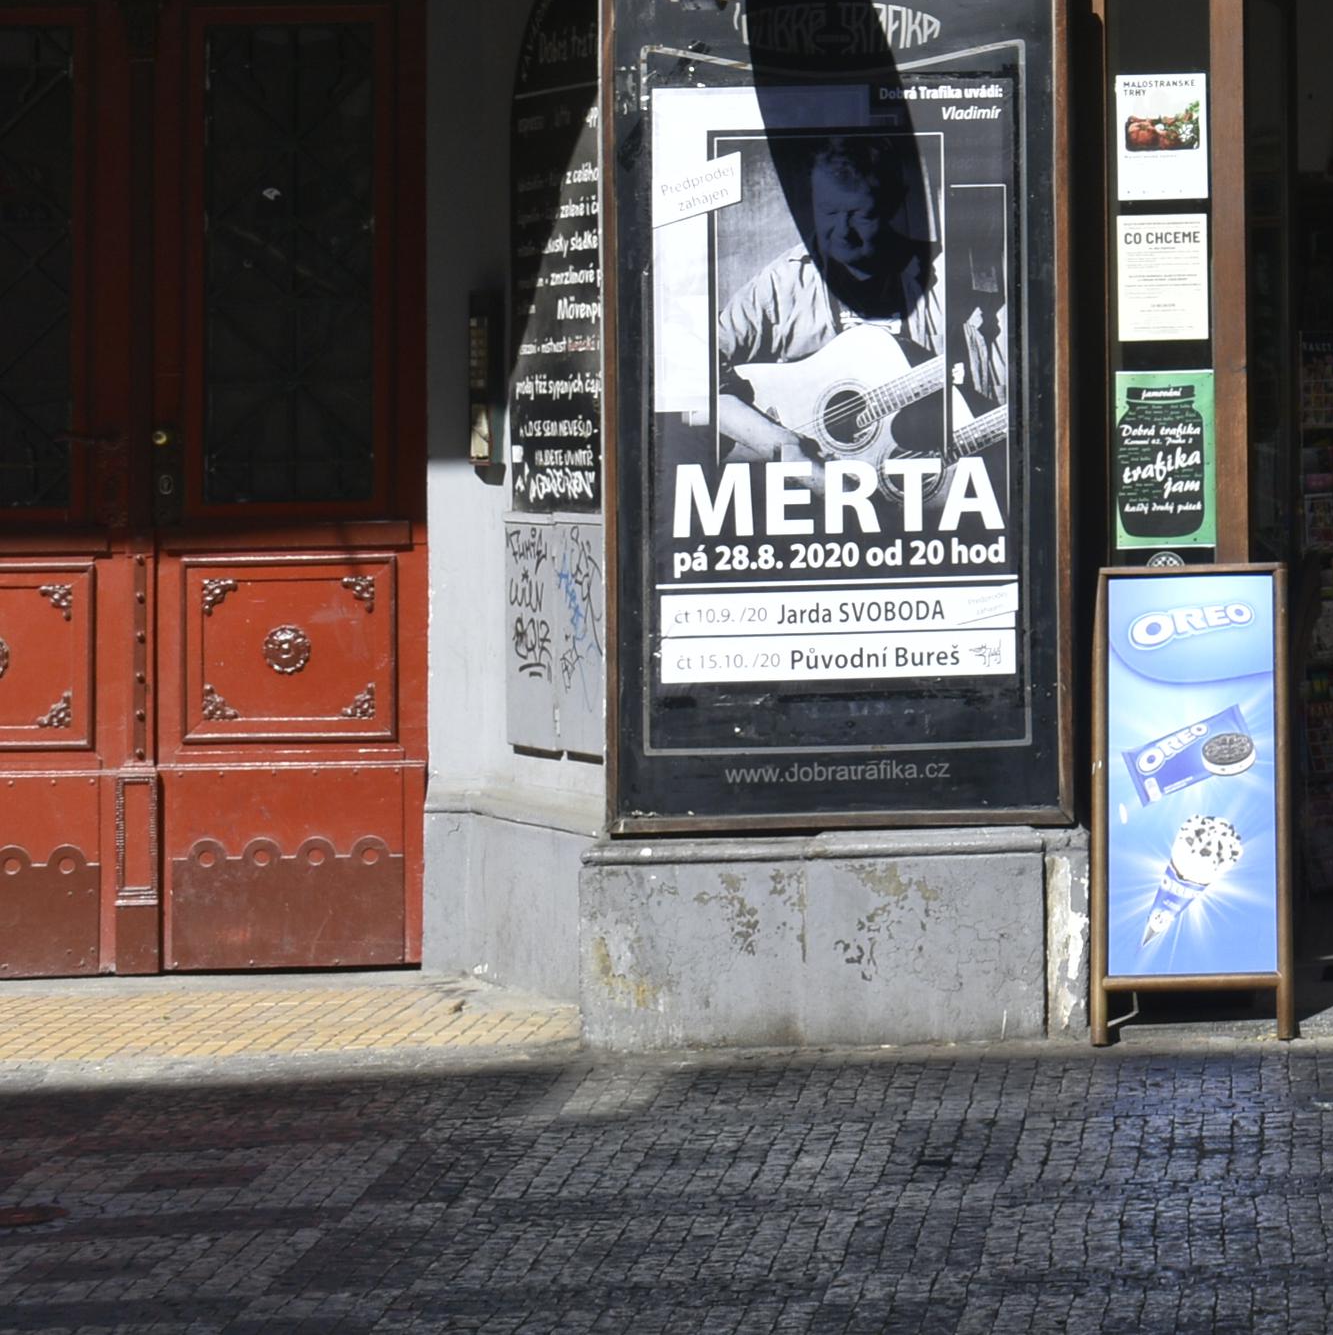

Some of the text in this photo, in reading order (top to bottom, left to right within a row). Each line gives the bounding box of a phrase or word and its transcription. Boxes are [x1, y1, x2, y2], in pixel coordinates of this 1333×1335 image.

[837, 1, 942, 55] TRAFIKA
[879, 84, 1003, 100] Dobrá Trafika uvádí:
[1123, 89, 1146, 97] TRHY
[941, 105, 1002, 121] Vladimír
[1124, 230, 1201, 245] CO CHCEME
[1159, 423, 1201, 438] trafika
[1122, 446, 1202, 484] trafika
[672, 457, 1006, 538] MERTA
[1163, 477, 1201, 499] jam
[673, 536, 1006, 578] pá 28.8. 2020 od 20 hod
[673, 600, 945, 625] čt 10.9. /20 Jarda SVOBODA
[1131, 602, 1254, 648] OREO
[676, 645, 960, 674] čt 15.10. /20 Původní Bureš
[1137, 722, 1209, 775] OREO
[725, 759, 952, 785] www.dobratrafika.cz
